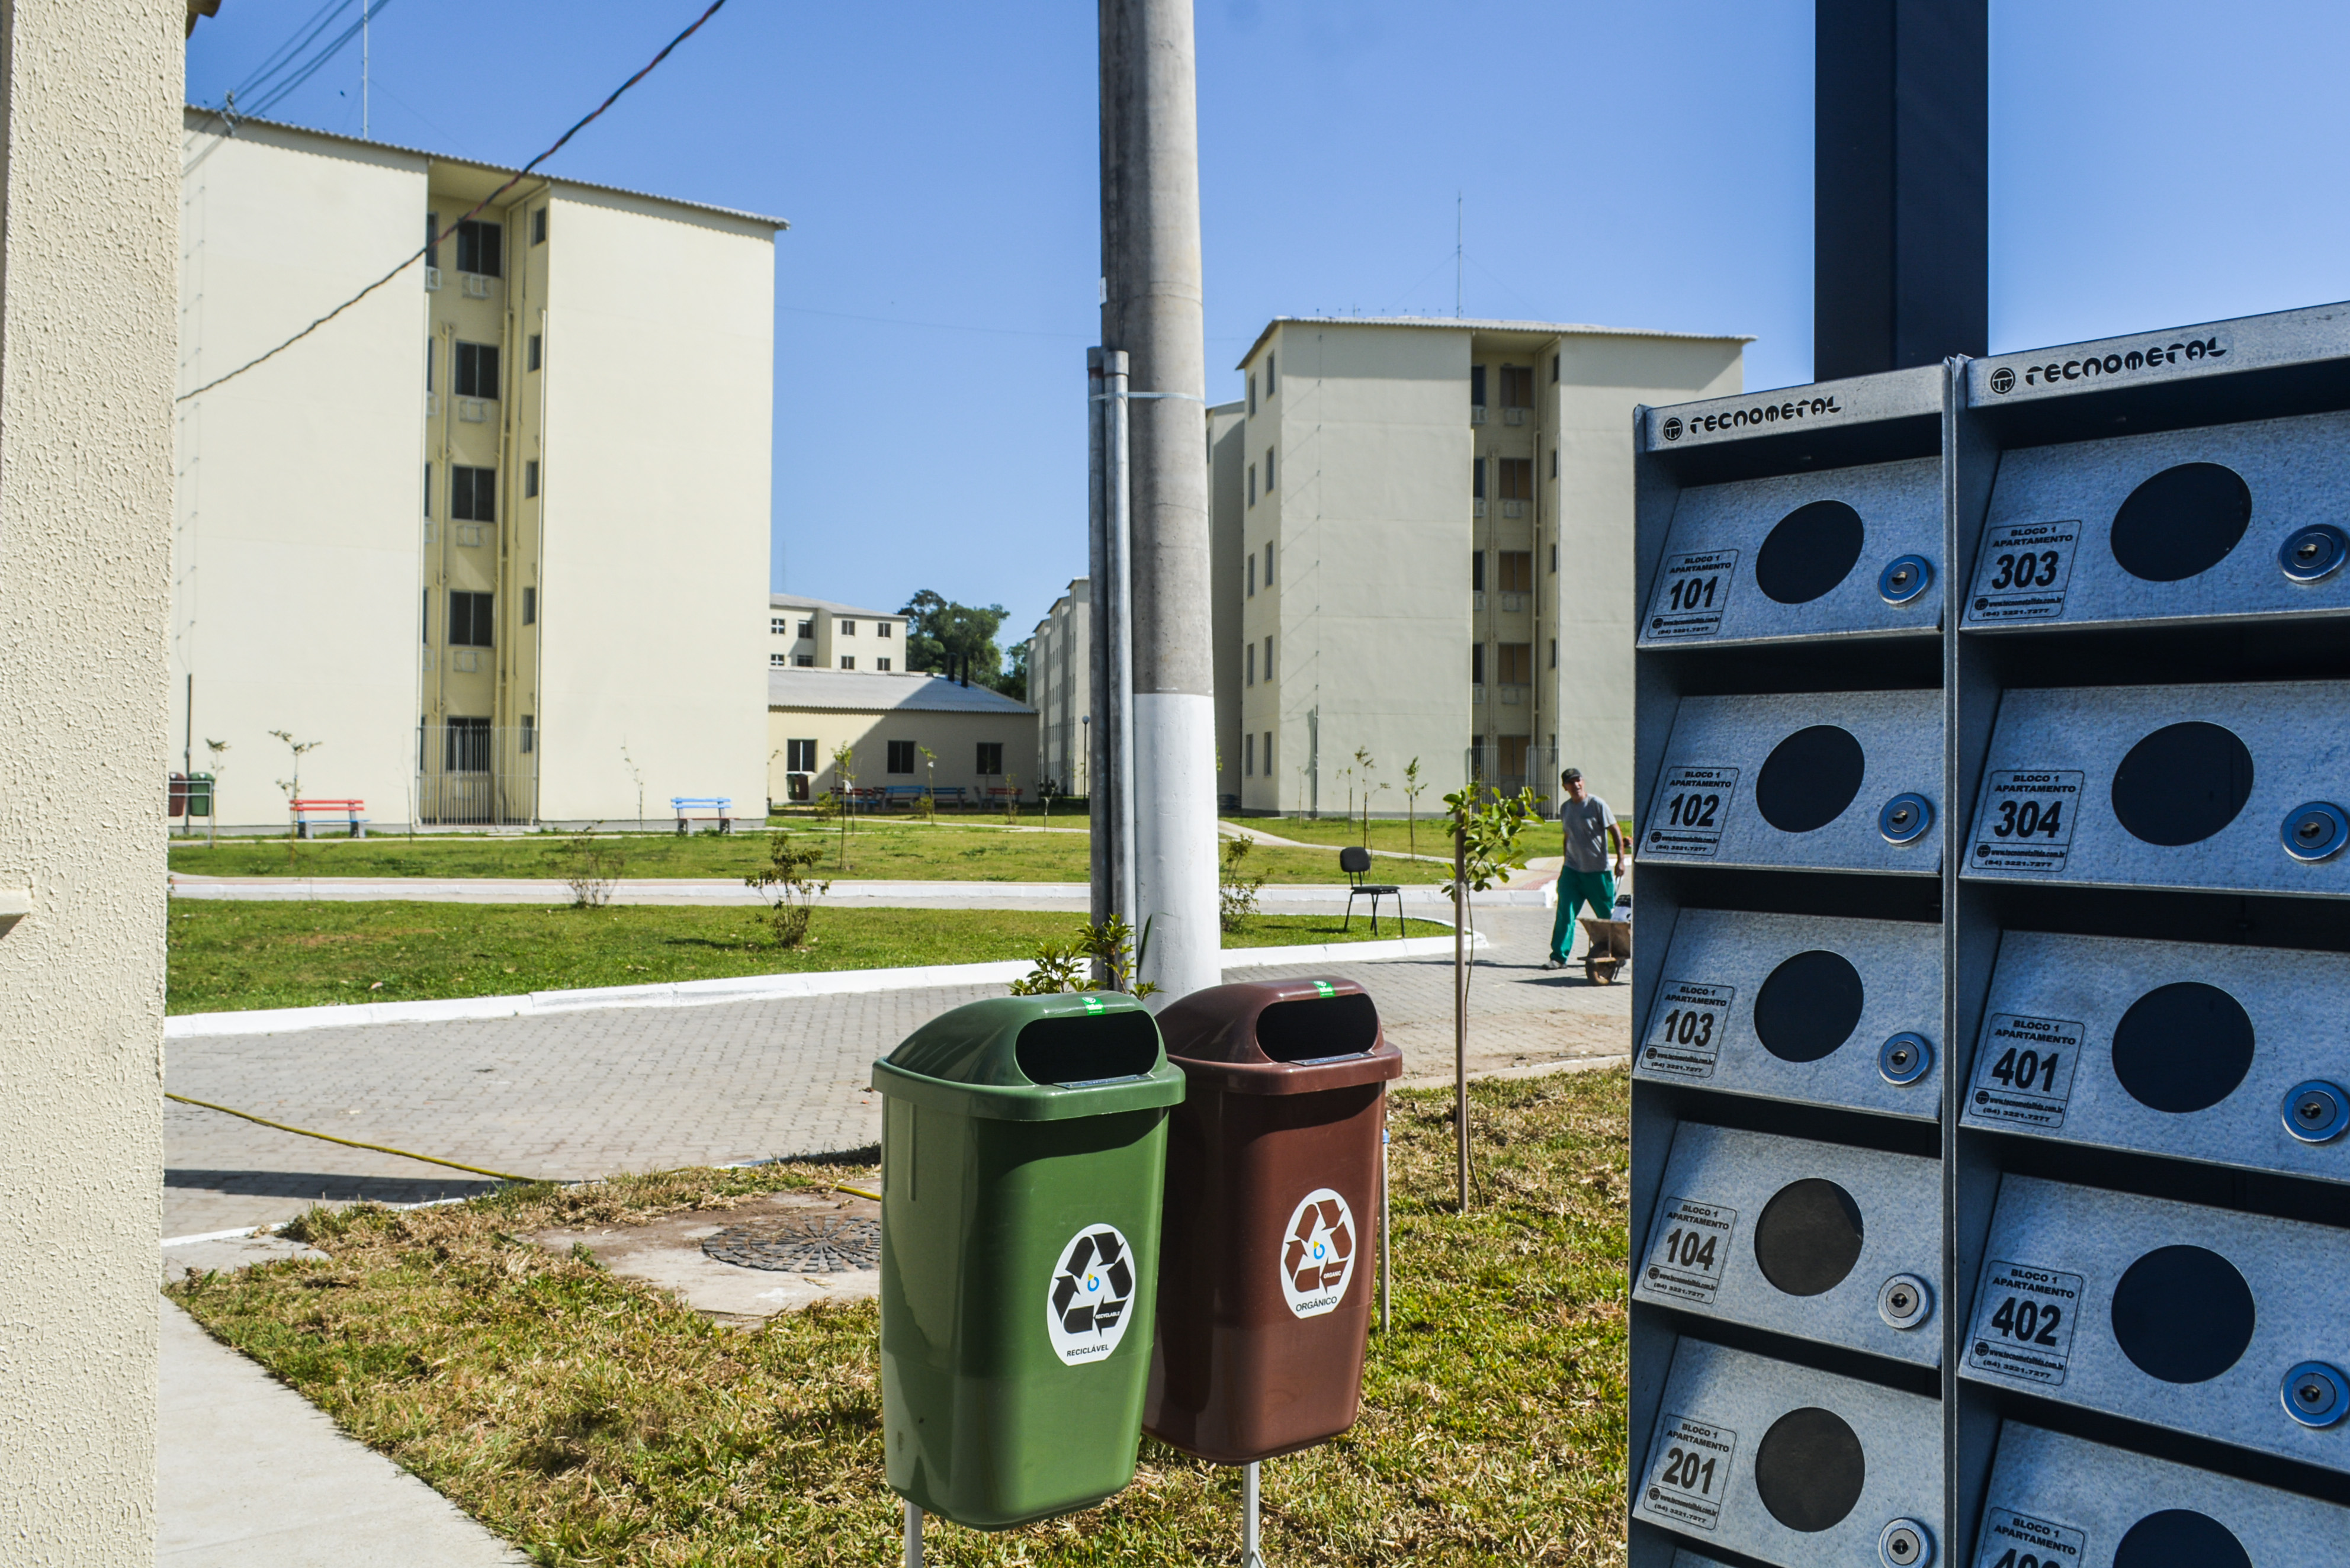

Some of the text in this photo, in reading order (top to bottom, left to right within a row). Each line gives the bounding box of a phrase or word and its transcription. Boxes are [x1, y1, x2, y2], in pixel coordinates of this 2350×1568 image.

[2025, 337, 2227, 385] TECNOMETAL
[1690, 396, 1841, 433] TECNOMETAL
[2011, 527, 2047, 536] BLOCO
[1992, 535, 2073, 547] APARTAMENTO
[1670, 563, 1731, 573] APARTAMENTO
[1992, 551, 2059, 589] 303
[1670, 576, 1718, 610] 101
[1670, 793, 1719, 827] 102
[1994, 801, 2062, 838] 304
[1680, 987, 1708, 995] BLOCO
[1665, 994, 1727, 1007] APARTAMENTO
[1665, 1009, 1714, 1047] 103
[2014, 1020, 2050, 1031] BLOCO
[1995, 1029, 2076, 1045] APARTAMENTO
[1992, 1048, 2059, 1092] 401
[2003, 1110, 2050, 1122] 3221.7277
[1682, 1205, 1710, 1216] BLOCO
[1667, 1212, 1729, 1230] APARTAMENTO
[1667, 1228, 1717, 1271] 104
[2011, 1269, 2048, 1282] BLOCO
[1993, 1277, 2074, 1299] APARTAMENTO
[1296, 1296, 1337, 1312] ORGÂNICO
[1095, 1311, 1120, 1319] RECYCLABLE
[1991, 1297, 2060, 1347] 402
[1067, 1344, 1109, 1357] RECICLÁVEL
[1983, 1360, 2051, 1379] (54) 3221.7277
[1682, 1423, 1710, 1436] BLOCO
[1667, 1430, 1729, 1452] APARTAMENTO
[1662, 1447, 1716, 1494] 201
[2013, 1518, 2050, 1535] BLOCO
[1994, 1525, 2076, 1555] APARTAMENTO
